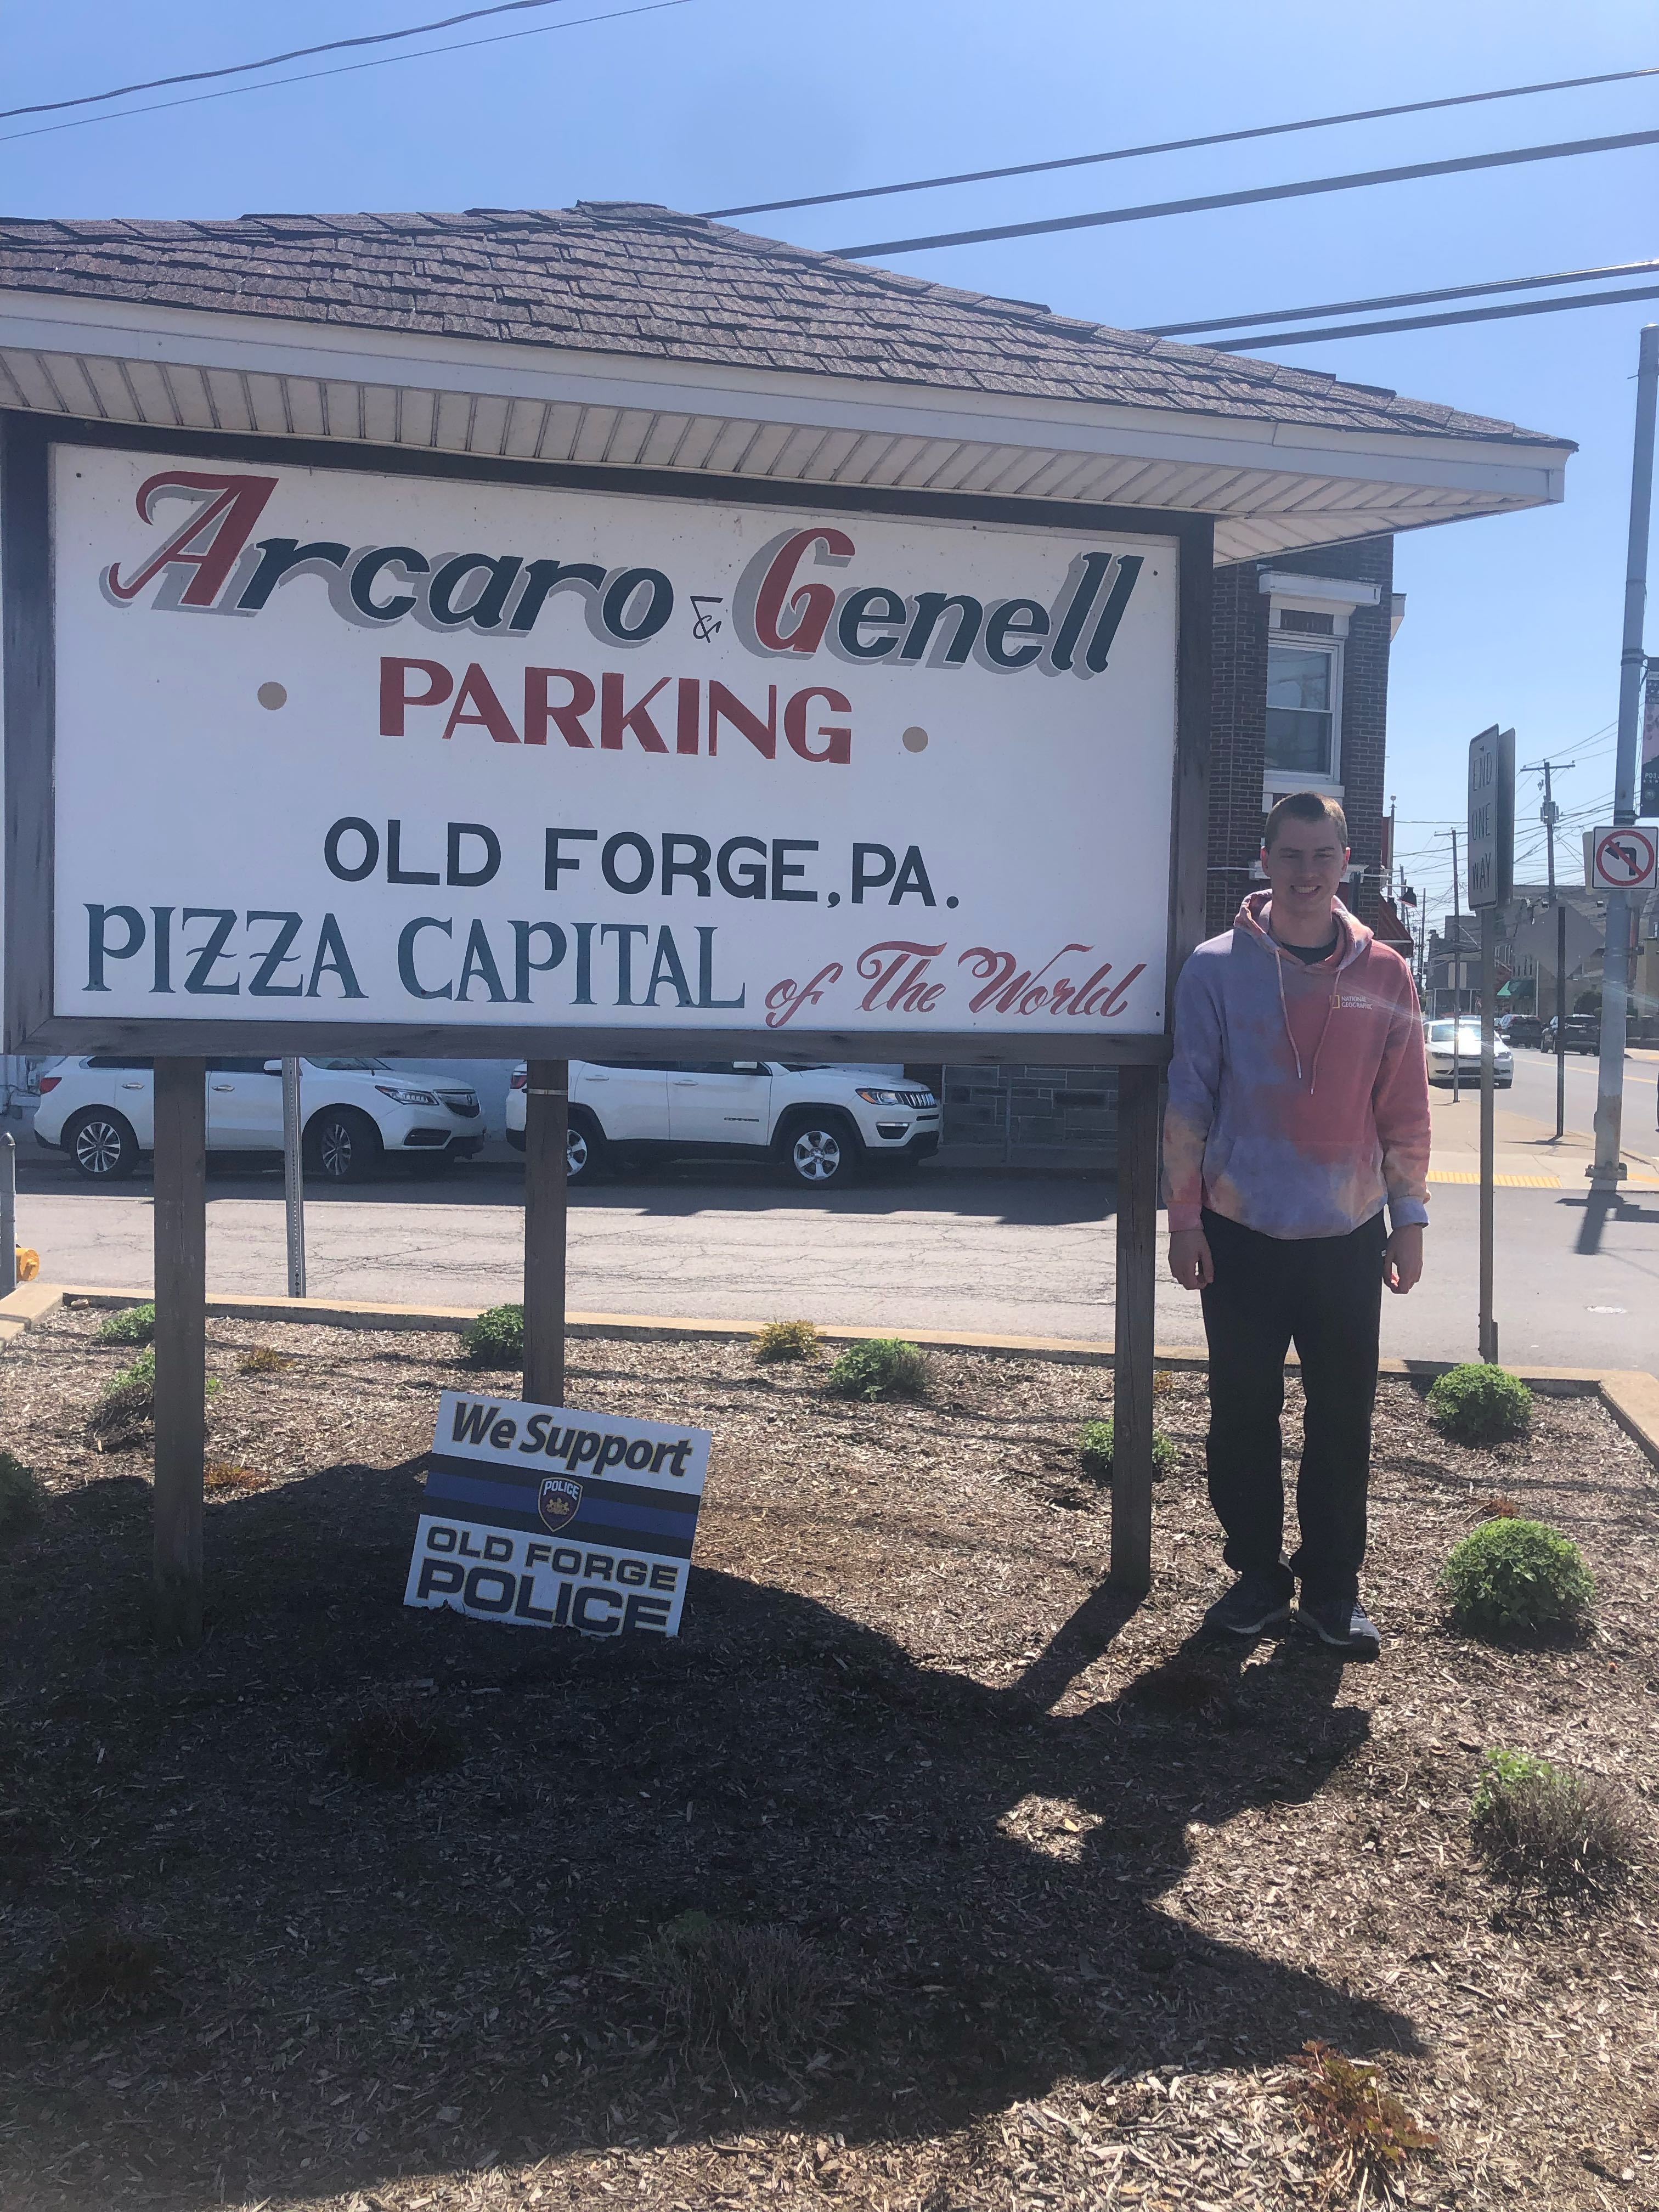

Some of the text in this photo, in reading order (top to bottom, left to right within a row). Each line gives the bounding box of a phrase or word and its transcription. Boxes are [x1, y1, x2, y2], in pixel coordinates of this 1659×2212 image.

[108, 471, 674, 642] Arcaro
[753, 527, 1145, 674] Genell
[379, 656, 852, 764] PARKING
[1473, 752, 1492, 792] END
[324, 816, 501, 887] OLD
[1472, 803, 1491, 841] ONE
[1472, 852, 1492, 890] WAY
[81, 902, 1148, 1029] PIZZA CAPITAL of The World
[452, 1400, 695, 1479] We Support
[543, 1480, 579, 1501] POLICE
[426, 1525, 680, 1593] OLD FORGE
[416, 1556, 673, 1634] POLICE
